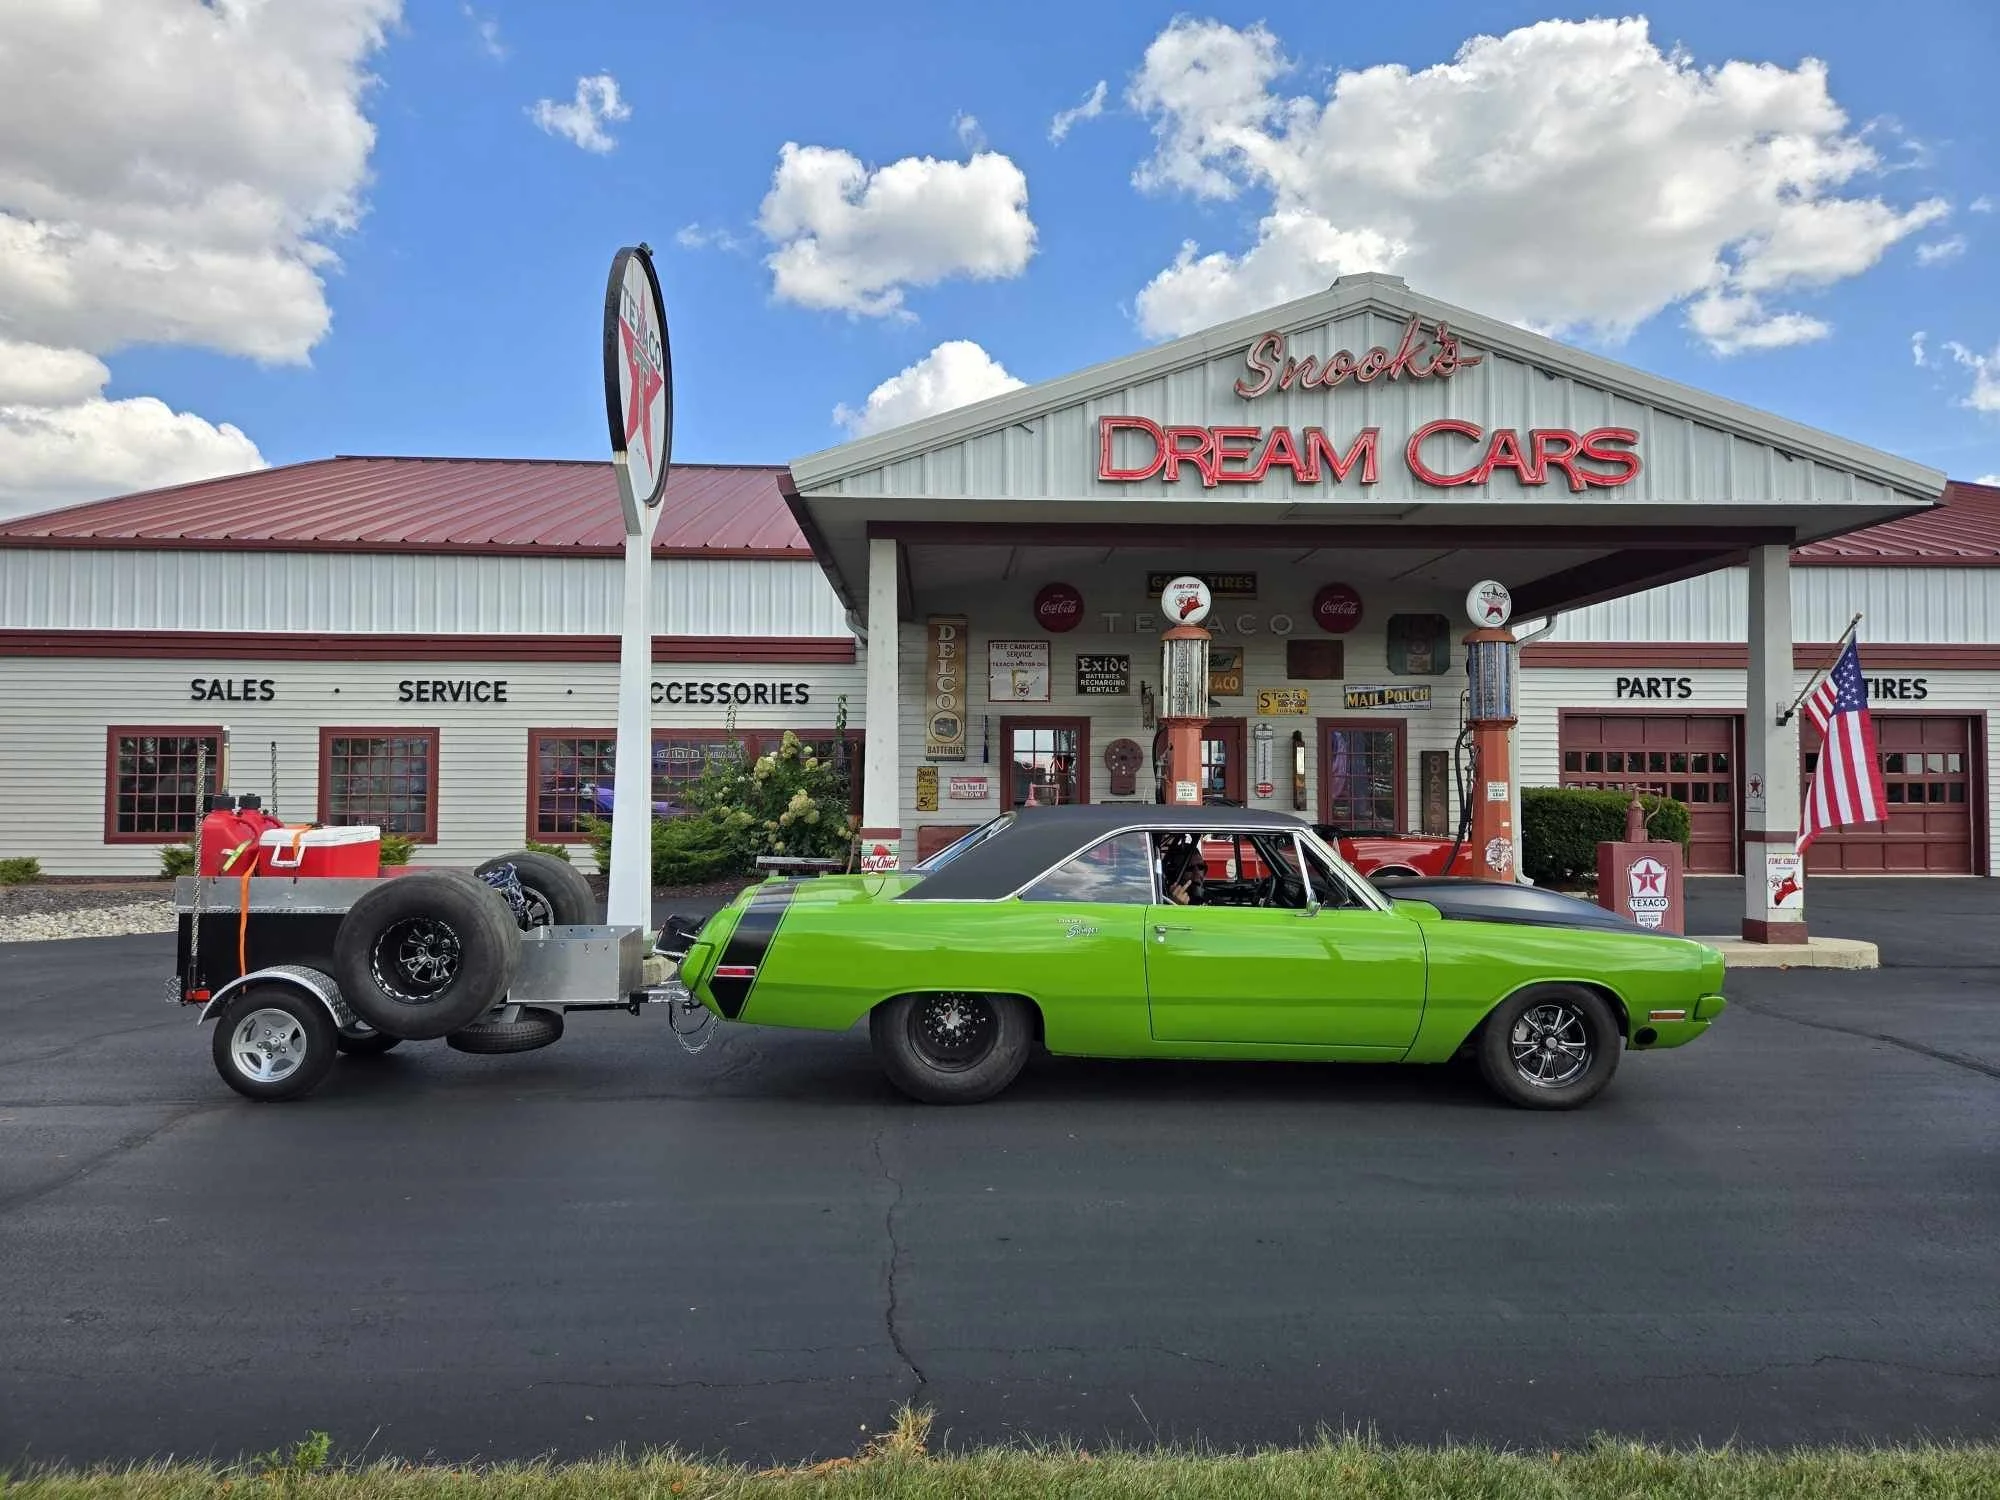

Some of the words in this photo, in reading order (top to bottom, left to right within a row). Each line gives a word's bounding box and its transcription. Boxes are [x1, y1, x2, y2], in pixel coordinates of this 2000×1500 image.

[621, 284, 662, 372] TEXACO
[1233, 312, 1483, 401] Snook's
[1098, 415, 1380, 487] DREAM
[1404, 418, 1643, 493] CARS
[1208, 575, 1254, 588] TIRES
[1481, 591, 1509, 599] TEXACO
[1100, 612, 1293, 635] TEACO
[936, 624, 957, 710] DELCO
[1078, 657, 1128, 672] Exide
[191, 678, 275, 701] SALES
[398, 680, 507, 703] SERVICE
[651, 681, 810, 705] CCESSORIES
[1347, 692, 1382, 707] MAIL
[1384, 688, 1429, 704] POUCH
[1616, 677, 1693, 699] PARTS
[1863, 678, 1928, 700] TIRES
[927, 747, 964, 755] BATTERIES
[918, 768, 936, 777] Spark
[918, 775, 937, 784] Plugs
[862, 856, 876, 871] Sky
[877, 856, 899, 869] Chief
[1632, 899, 1667, 907] TEXACO
